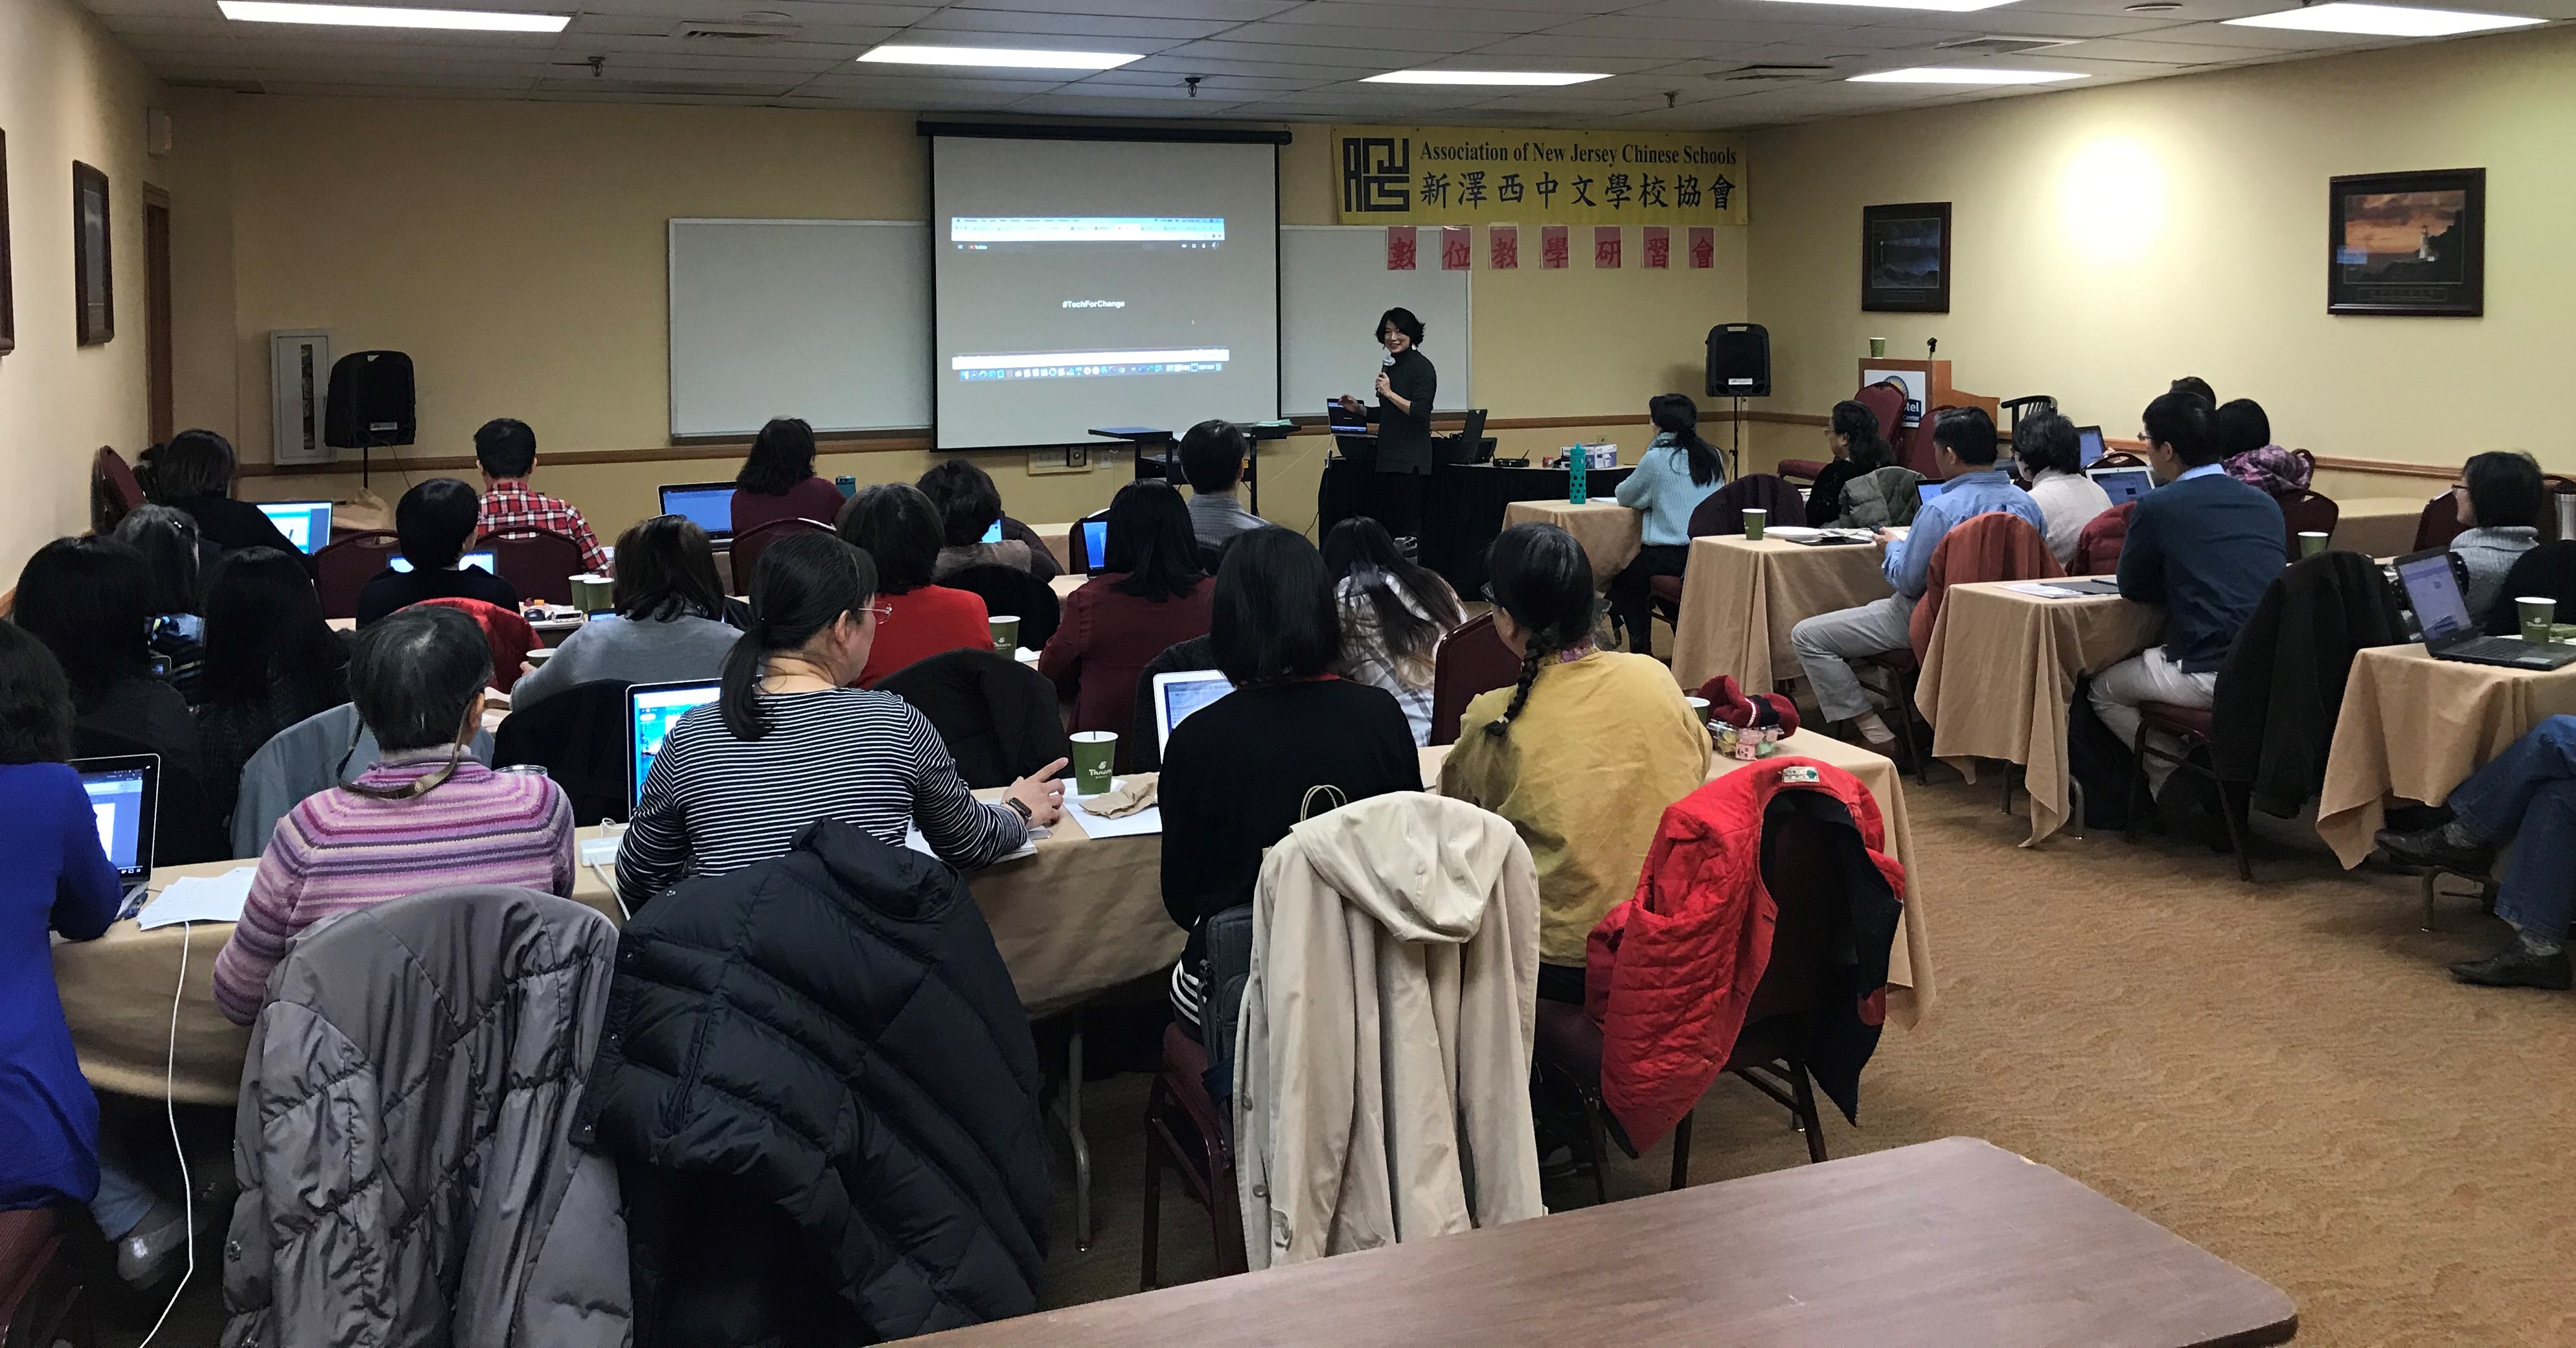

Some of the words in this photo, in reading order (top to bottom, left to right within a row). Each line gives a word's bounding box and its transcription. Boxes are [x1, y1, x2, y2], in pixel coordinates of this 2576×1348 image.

[1420, 141, 1508, 161] Association
[1513, 142, 1529, 161] of
[1533, 143, 1566, 161] New
[1570, 143, 1617, 167] Jersey
[1622, 143, 1679, 163] Chinese
[1683, 145, 1737, 165] Schools
[1420, 170, 1737, 211] 新澤西中文學校協會
[1062, 300, 1125, 308] #TechForChange
[1904, 402, 1919, 412] tel
